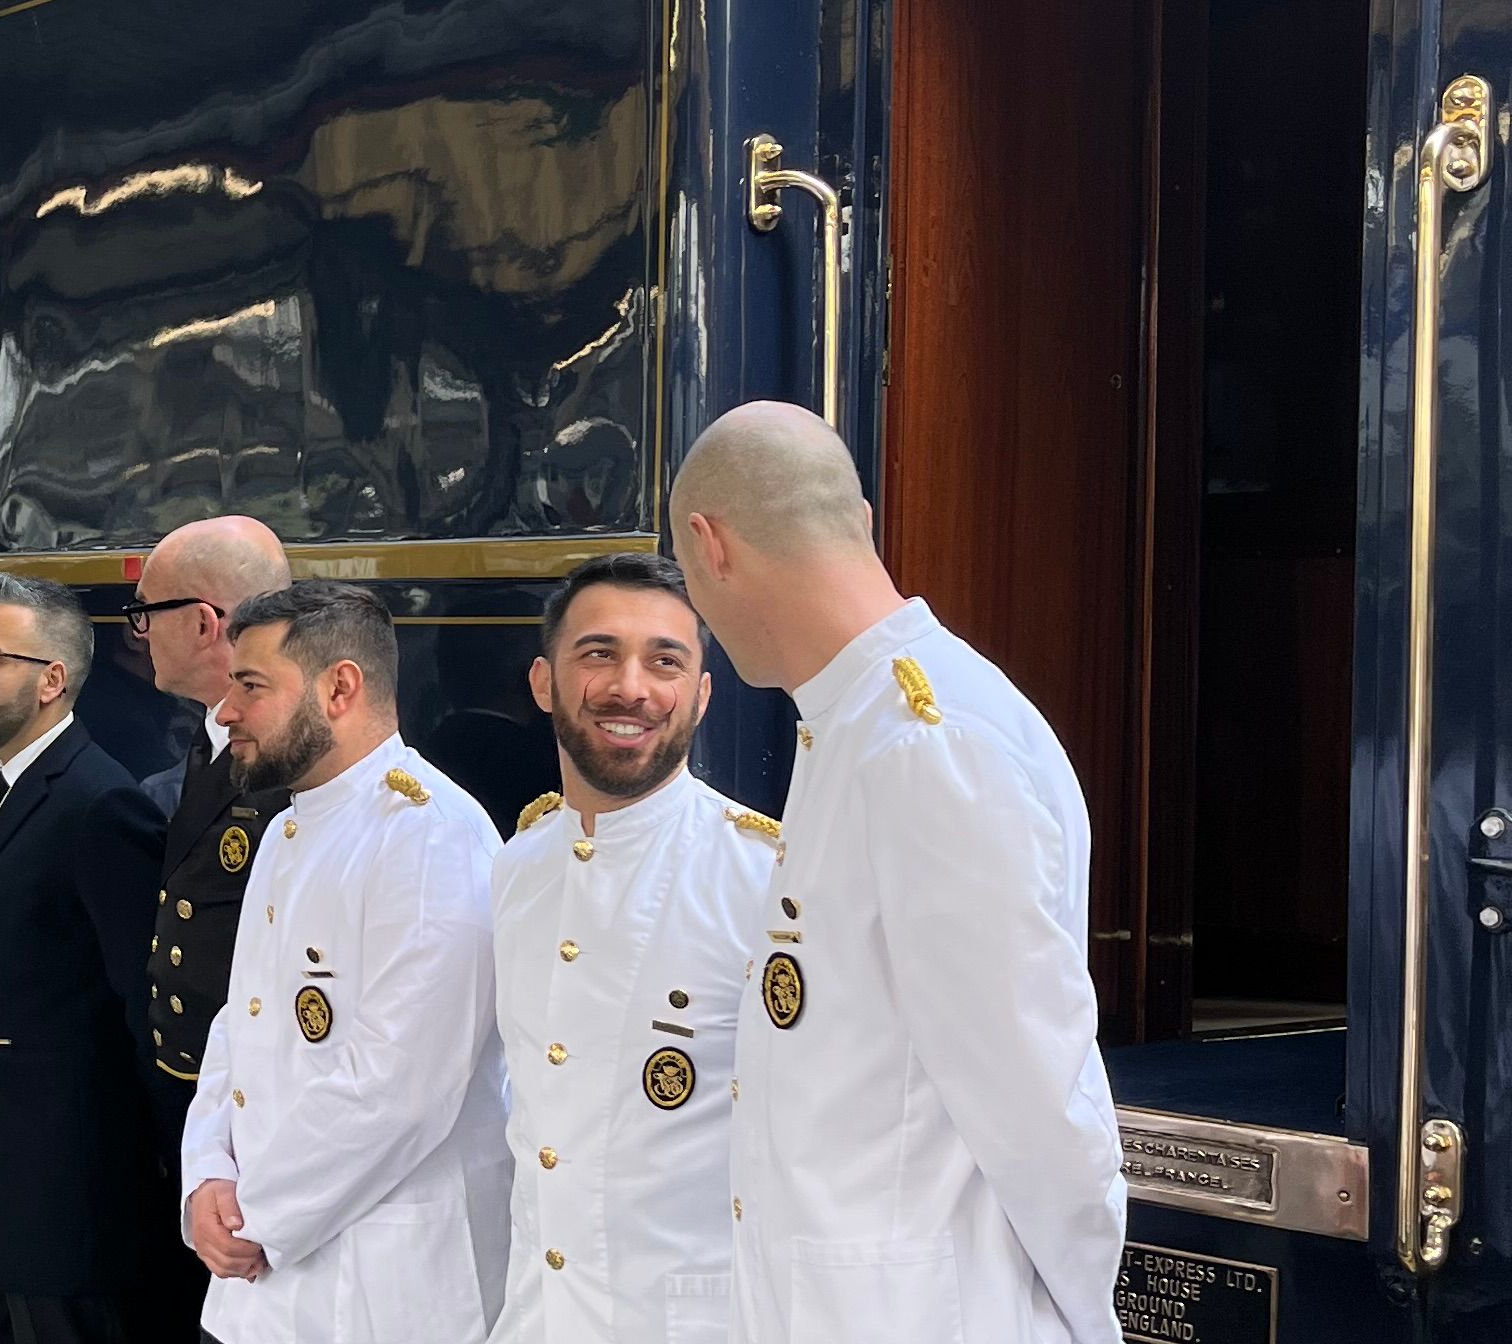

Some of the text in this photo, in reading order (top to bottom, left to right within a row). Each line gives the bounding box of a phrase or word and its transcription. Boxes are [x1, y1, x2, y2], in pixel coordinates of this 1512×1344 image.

[1146, 1274, 1201, 1302] HOUSE
[1226, 1269, 1263, 1294] LTD.
[1116, 1290, 1186, 1319] GROUND
